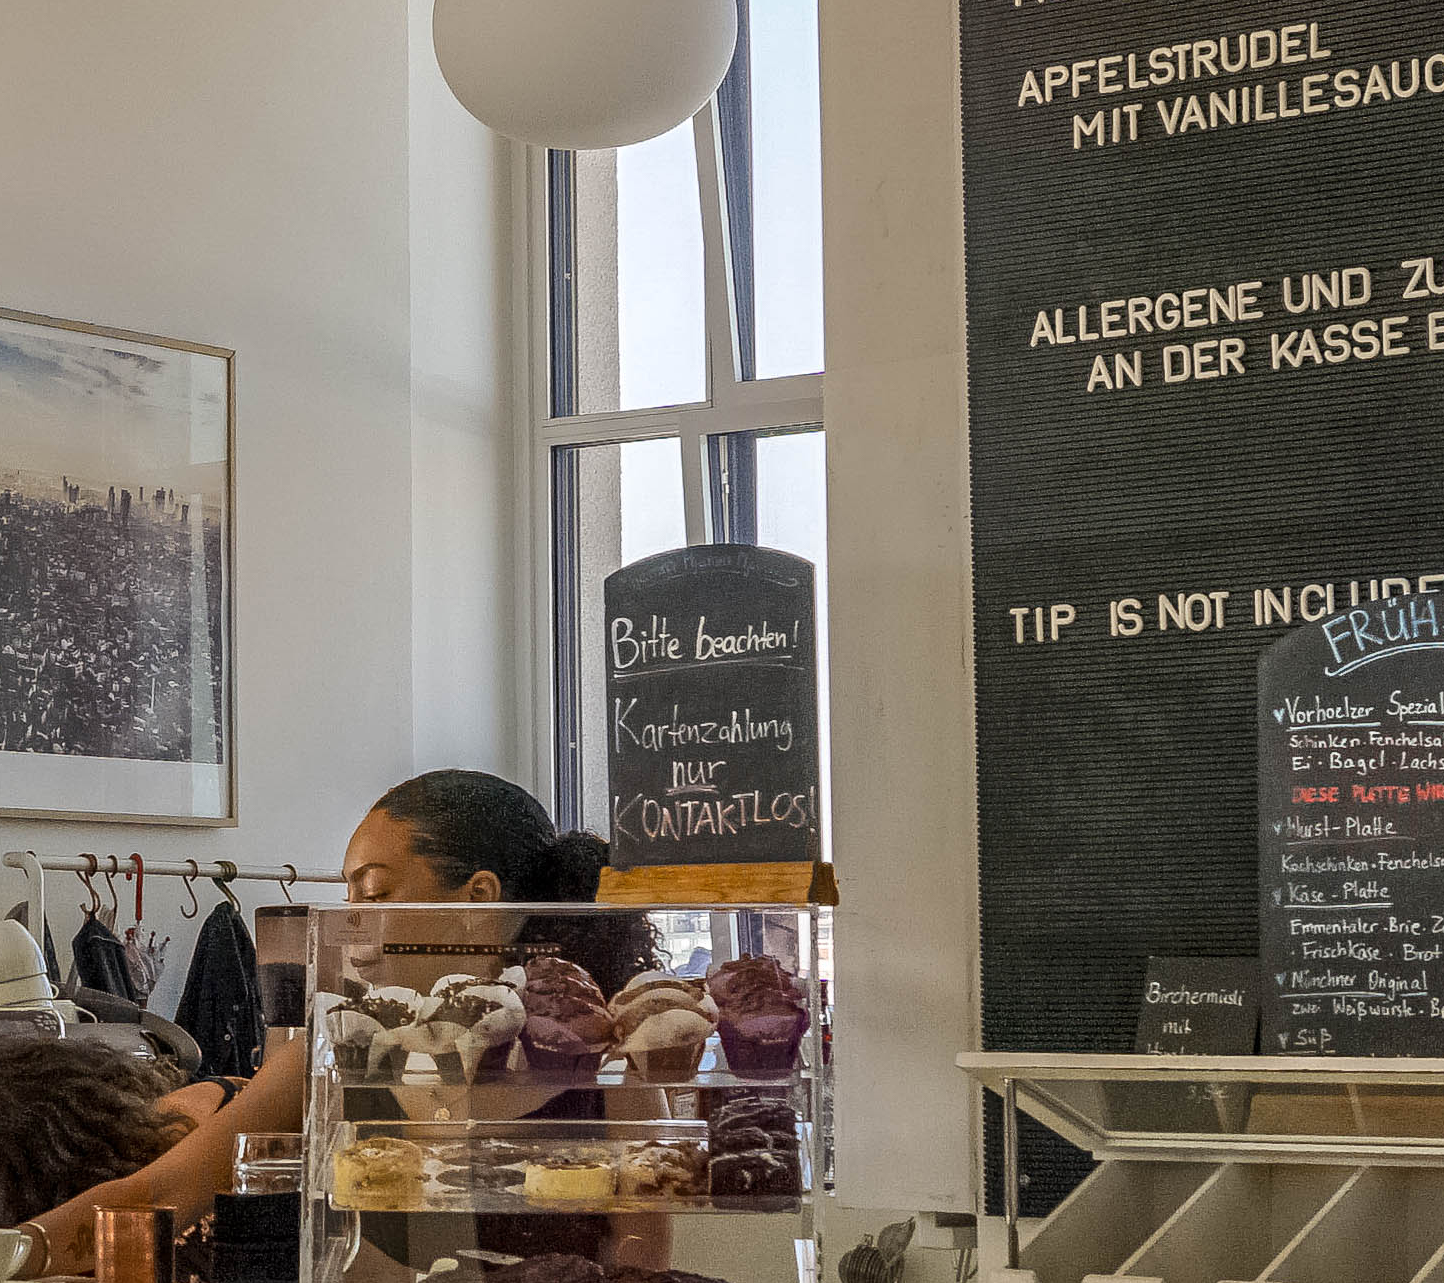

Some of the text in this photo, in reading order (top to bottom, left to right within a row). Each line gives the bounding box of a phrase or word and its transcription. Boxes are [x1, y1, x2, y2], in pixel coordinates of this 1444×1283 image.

[1017, 21, 1332, 108] APFELSTRUDEL
[1072, 103, 1143, 150] MIT
[1029, 280, 1264, 348] ALLERGENE
[1282, 266, 1372, 314] UND
[1086, 350, 1142, 393] AN
[1162, 337, 1246, 384] DER
[1270, 315, 1410, 371] KASSE
[1008, 603, 1076, 644] TIP
[1109, 597, 1144, 637] IS
[1157, 590, 1230, 632] NOT
[611, 615, 799, 668] Bitte beachten!
[614, 698, 792, 751] Kartenzahlung
[1285, 695, 1374, 723] Vorhoelzer
[1386, 690, 1444, 721] Spezial
[672, 759, 727, 788] nur
[1292, 754, 1312, 770] Ei
[1330, 750, 1385, 776] Bagel
[1290, 917, 1378, 936] Emmentaler
[1389, 916, 1421, 935] Brie
[1403, 943, 1443, 962] Brot
[1368, 969, 1428, 1001] Original
